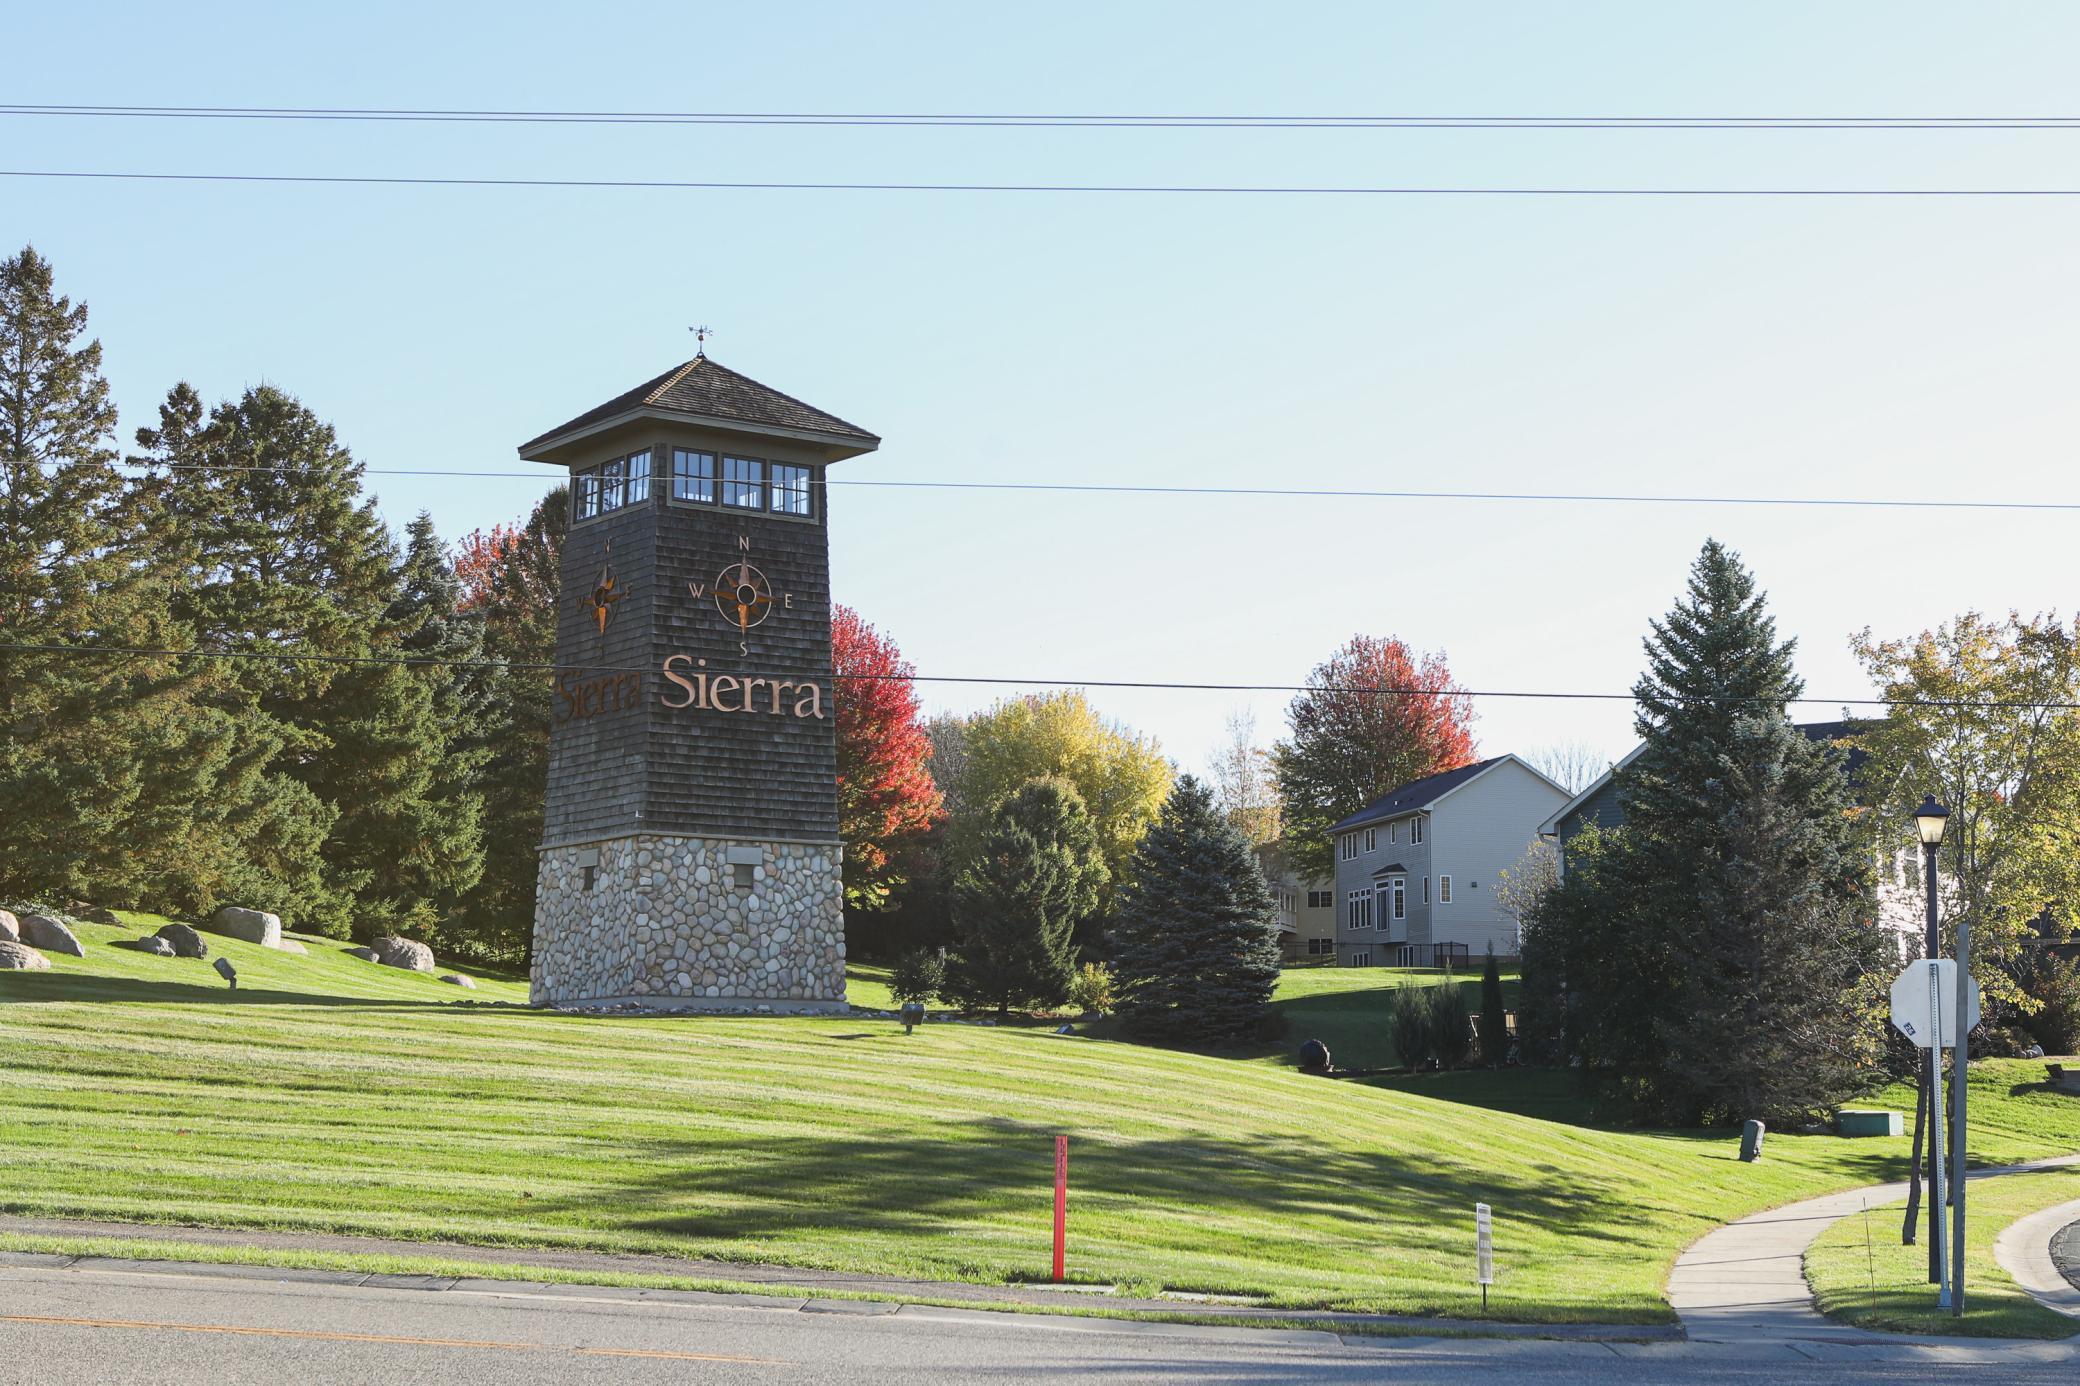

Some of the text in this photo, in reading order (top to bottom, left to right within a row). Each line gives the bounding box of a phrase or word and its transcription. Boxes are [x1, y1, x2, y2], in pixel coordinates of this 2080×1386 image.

[739, 536, 750, 551] N
[688, 582, 705, 599] W
[785, 594, 793, 609] E
[740, 641, 748, 657] S
[661, 654, 825, 720] Sierra
[556, 669, 641, 724] Sierra
